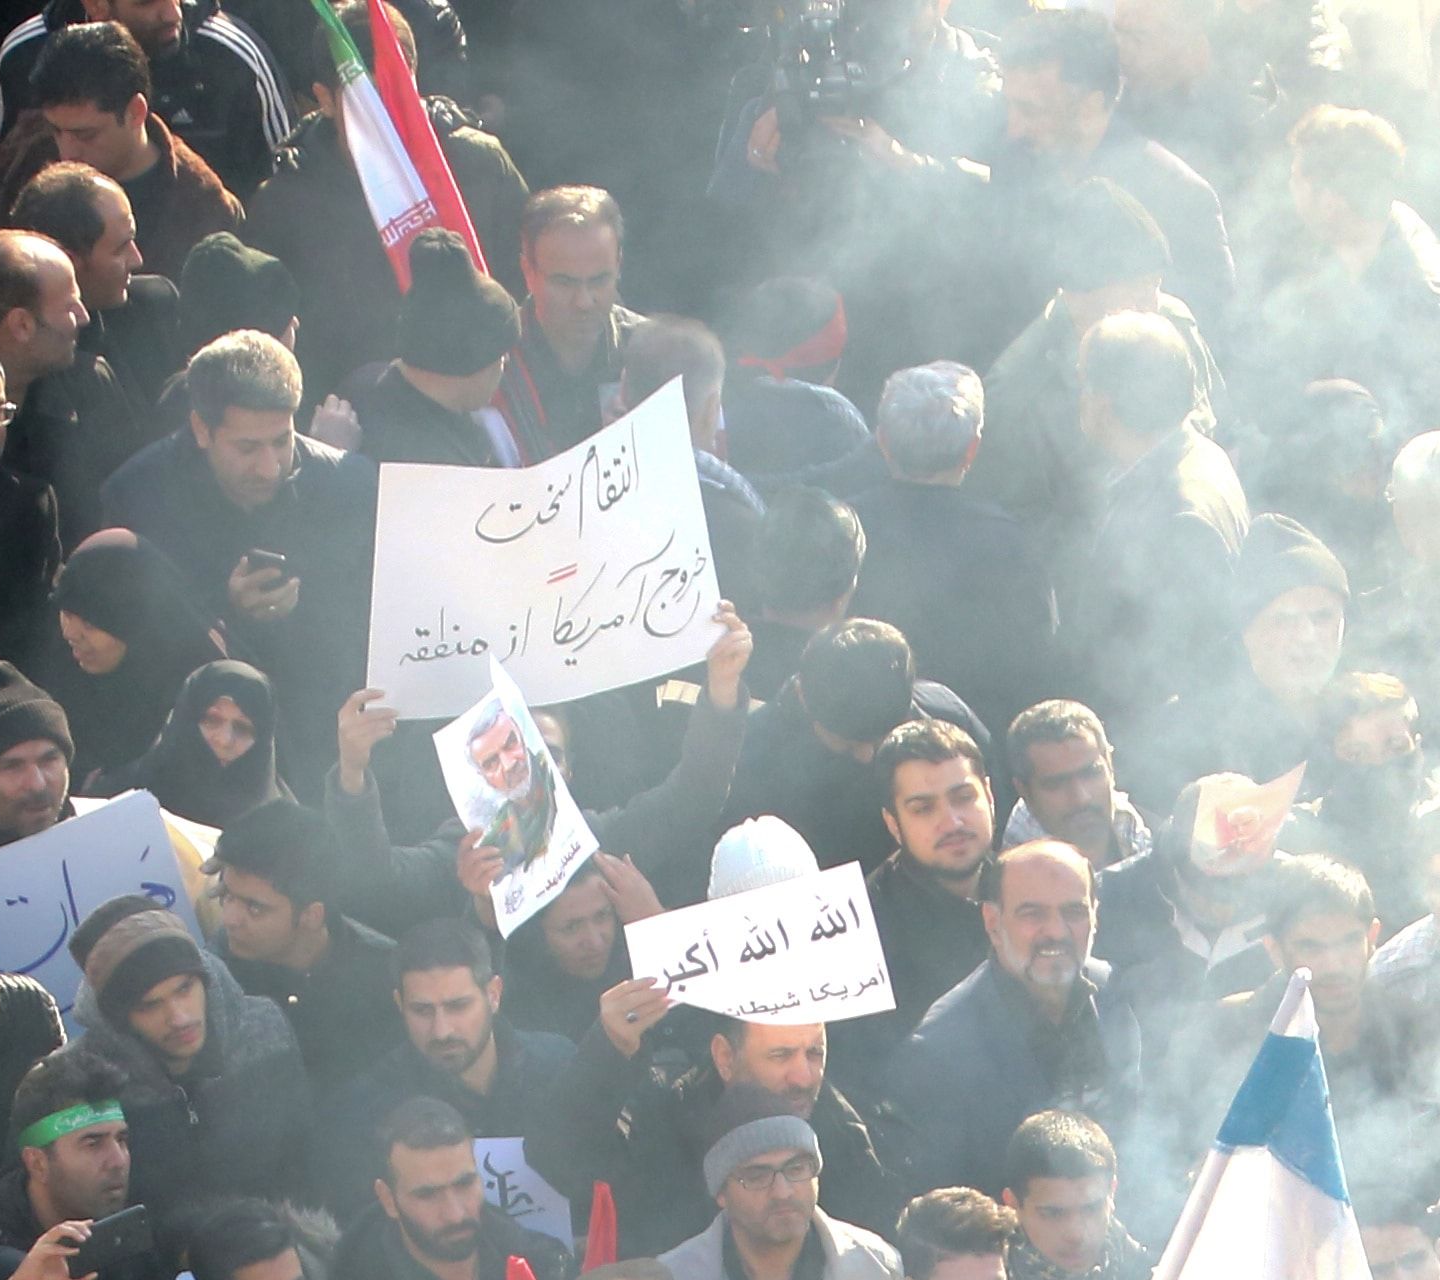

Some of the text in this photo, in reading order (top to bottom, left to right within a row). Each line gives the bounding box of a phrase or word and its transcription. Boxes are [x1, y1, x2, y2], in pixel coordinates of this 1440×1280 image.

[474, 421, 639, 544] انتقام سخت
[502, 606, 532, 663] از
[641, 547, 708, 637] خروج
